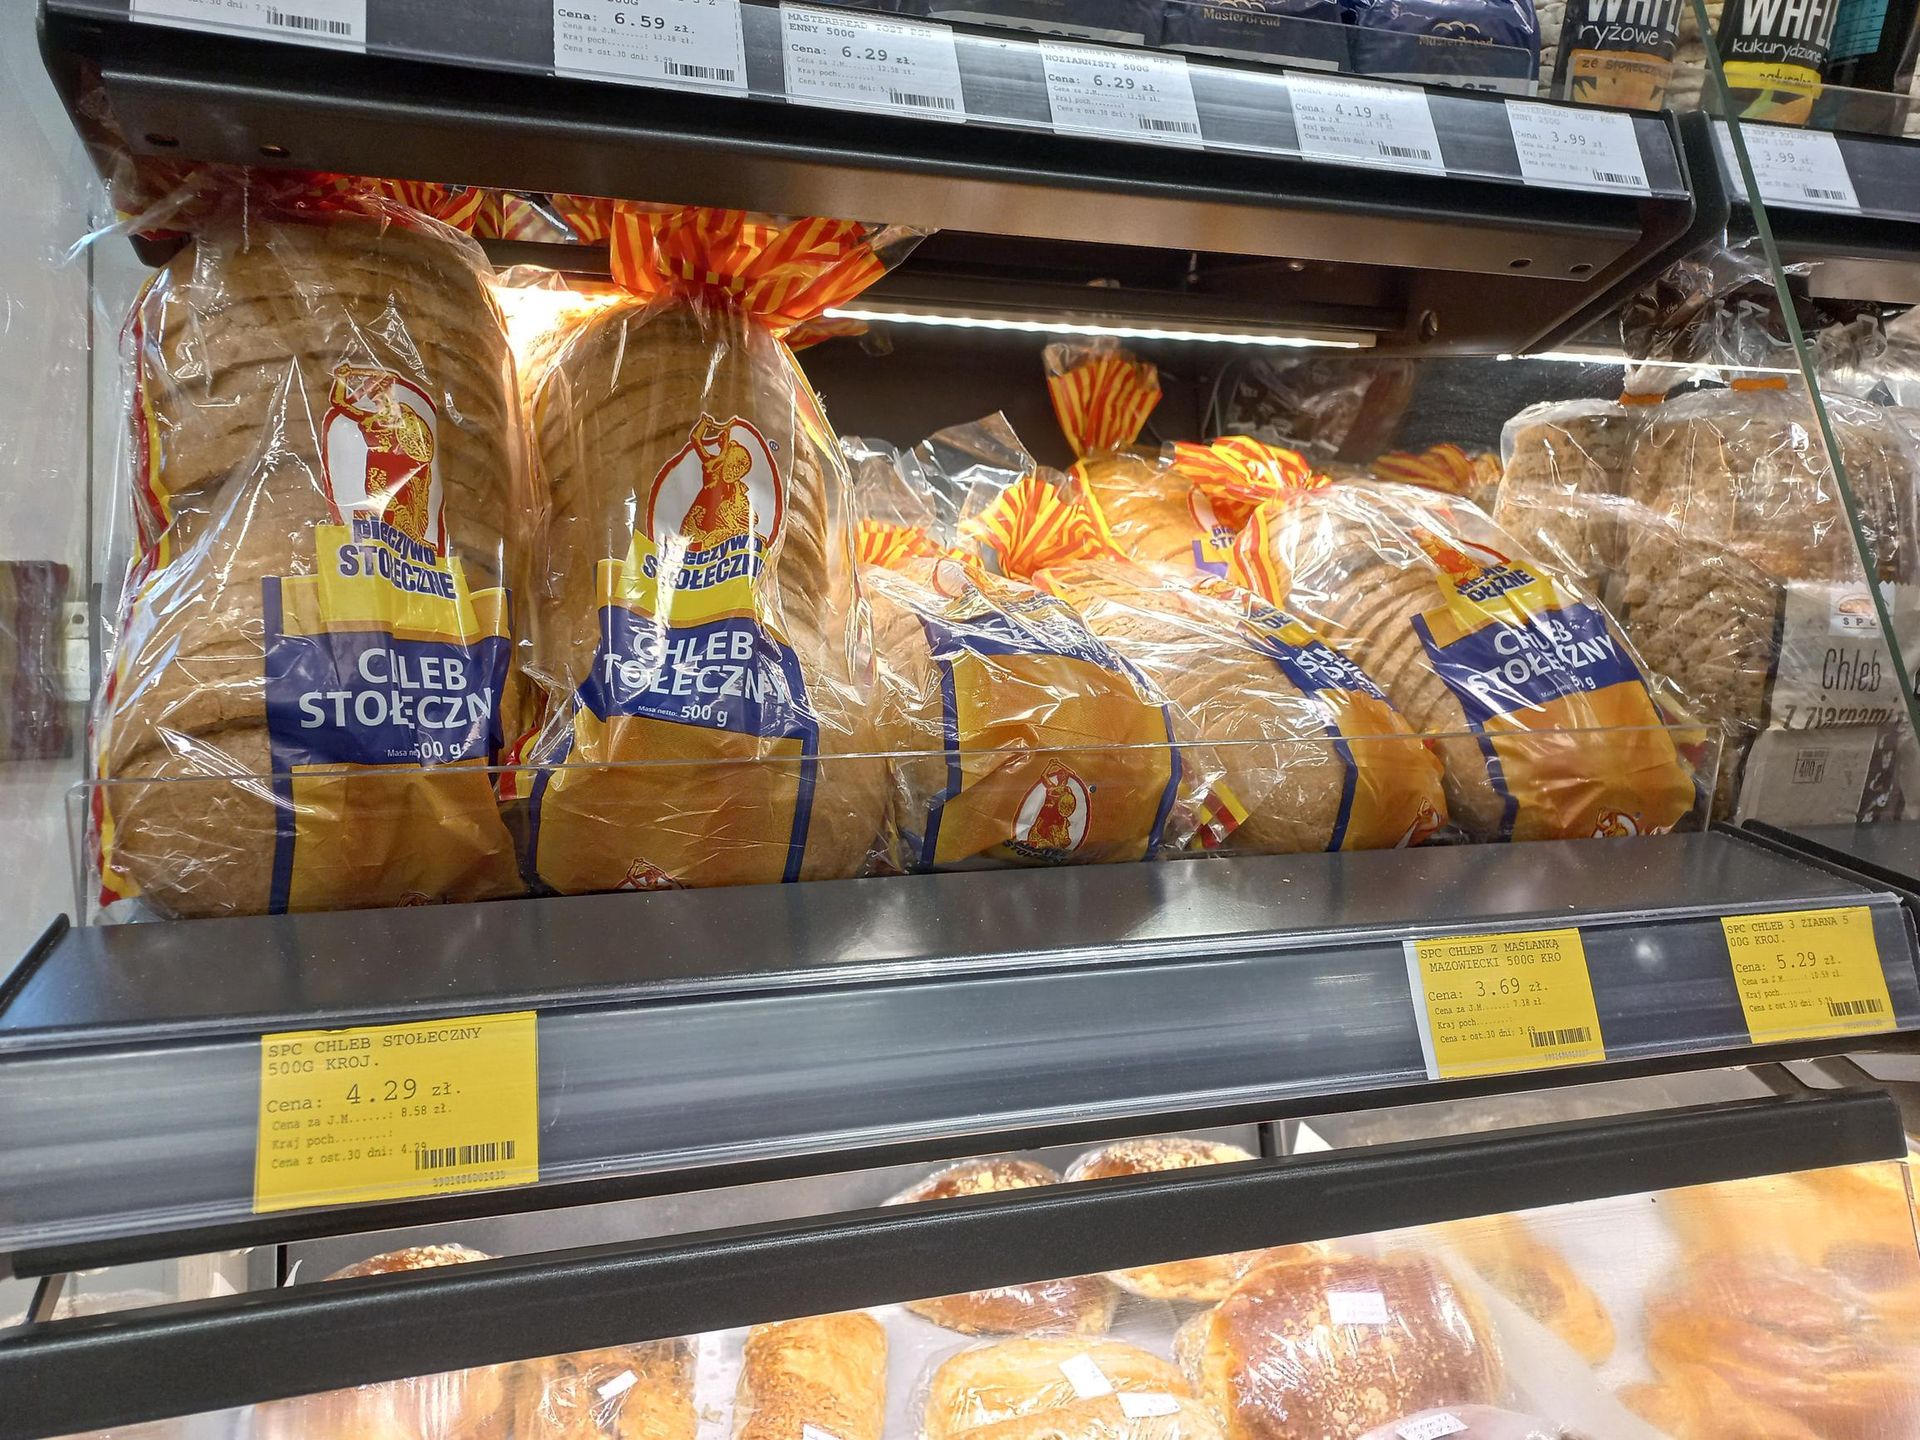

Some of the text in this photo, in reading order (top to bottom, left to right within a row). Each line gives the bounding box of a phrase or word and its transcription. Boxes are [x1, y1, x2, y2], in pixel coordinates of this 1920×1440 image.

[558, 9, 695, 34] Cena: 6.59 zł.
[788, 13, 867, 29] MASTERBREAD
[789, 23, 855, 38] ENNY 500G
[1579, 23, 1659, 50] ryżowe
[791, 43, 916, 66] Cena: 6.29 zł.
[1123, 64, 1150, 73] 500G
[1048, 73, 1160, 93] Cena: 6.29 zł.
[1295, 103, 1325, 113] Cena:
[1335, 103, 1372, 118] 4.19
[1552, 131, 1586, 146] 3.99
[1763, 150, 1795, 164] 3.99
[642, 553, 766, 590] SOŁECZN
[632, 631, 755, 667] CHLEB
[603, 653, 787, 704] TOŁECZNY
[1822, 648, 1881, 692] Chleb
[299, 687, 493, 729] STOŁECZN
[638, 704, 729, 728] Masa netto: 500 g
[387, 749, 408, 757] Masa
[449, 743, 461, 759] g
[1727, 915, 1849, 934] SPC CHLEB 3 ZIARNA 5
[1420, 937, 1561, 959] SPC CHLEB Z MAŚLANKĄ
[1730, 934, 1786, 947] 00G KROJ.
[1430, 952, 1562, 973] MAZOWIECKI 500G KRO
[1735, 951, 1842, 974] Cena: 5.29 zł.
[1428, 977, 1549, 1002] Cena: 3.69 zł.
[1435, 1007, 1453, 1016] Cena
[1438, 1021, 1455, 1030] Kraj
[268, 1027, 482, 1058] SPC CHLEB STOŁECZNY
[1440, 1034, 1458, 1043] Cena
[268, 1055, 379, 1076] 500G KROJ.
[267, 1078, 462, 1114] Cena: 4.29 zł.
[272, 1120, 300, 1131] Cena
[308, 1117, 321, 1127] za
[401, 1105, 427, 1118] 8.58
[433, 1103, 452, 1115] zł.
[271, 1141, 427, 1169] Cena z ost.30 dni: 4.29
[272, 1138, 300, 1151] Kraj
